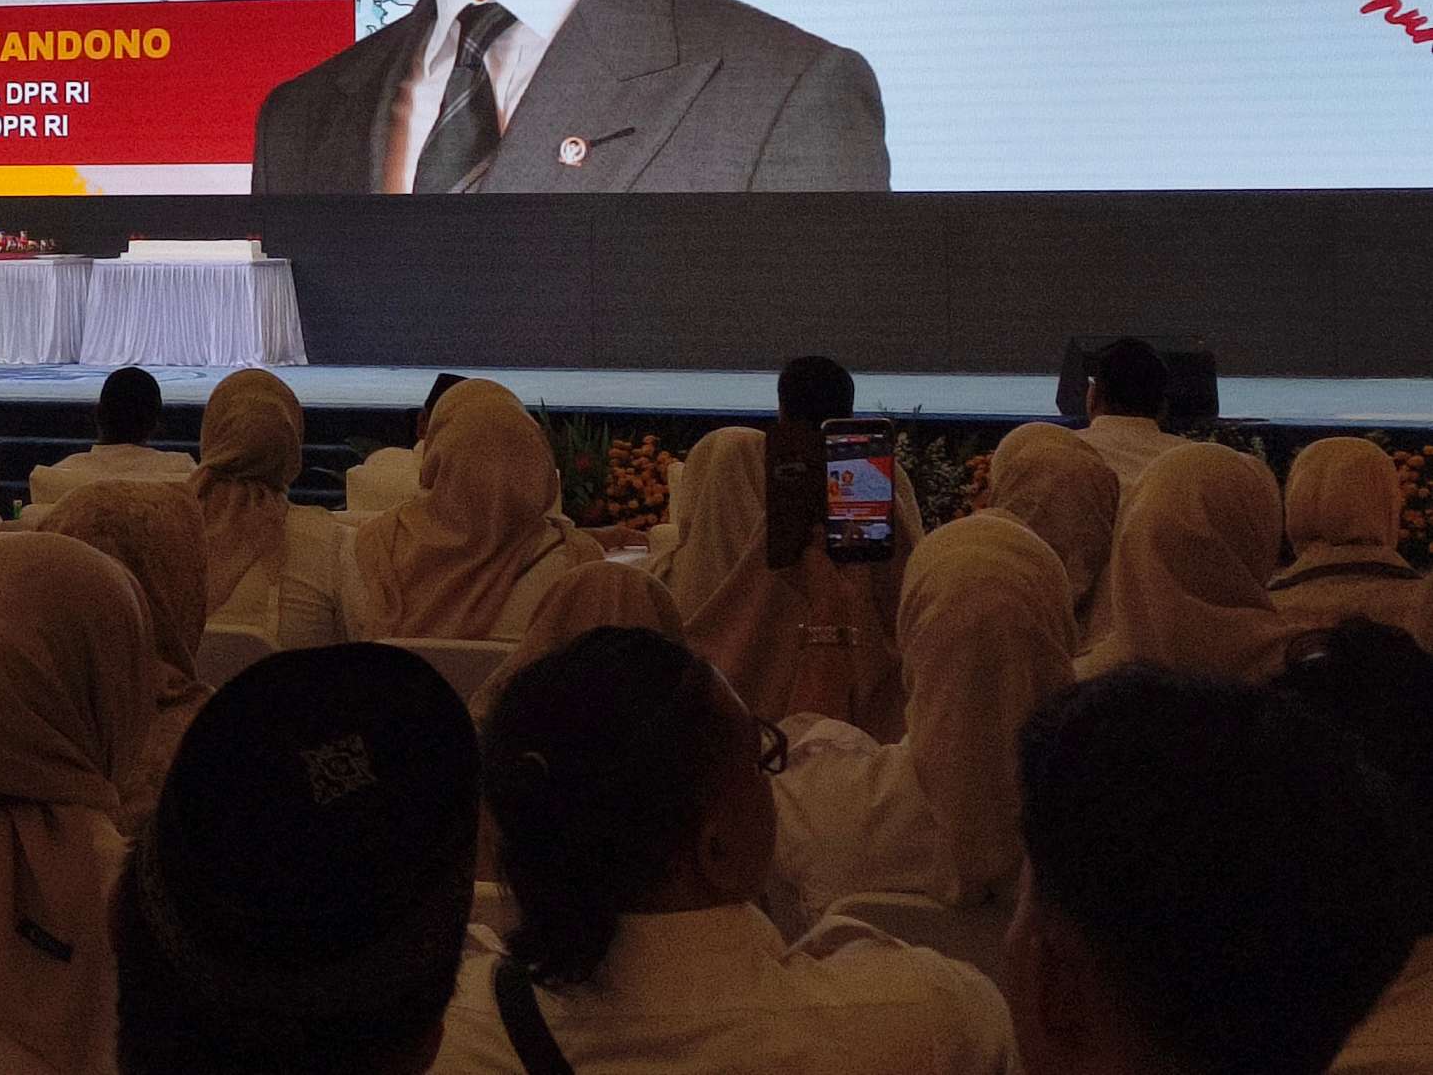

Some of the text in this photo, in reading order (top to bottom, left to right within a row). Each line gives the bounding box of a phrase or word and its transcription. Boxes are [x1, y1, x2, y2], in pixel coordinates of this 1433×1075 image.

[6, 82, 58, 105] DPR
[65, 81, 89, 104] RI
[44, 113, 69, 137] RI
